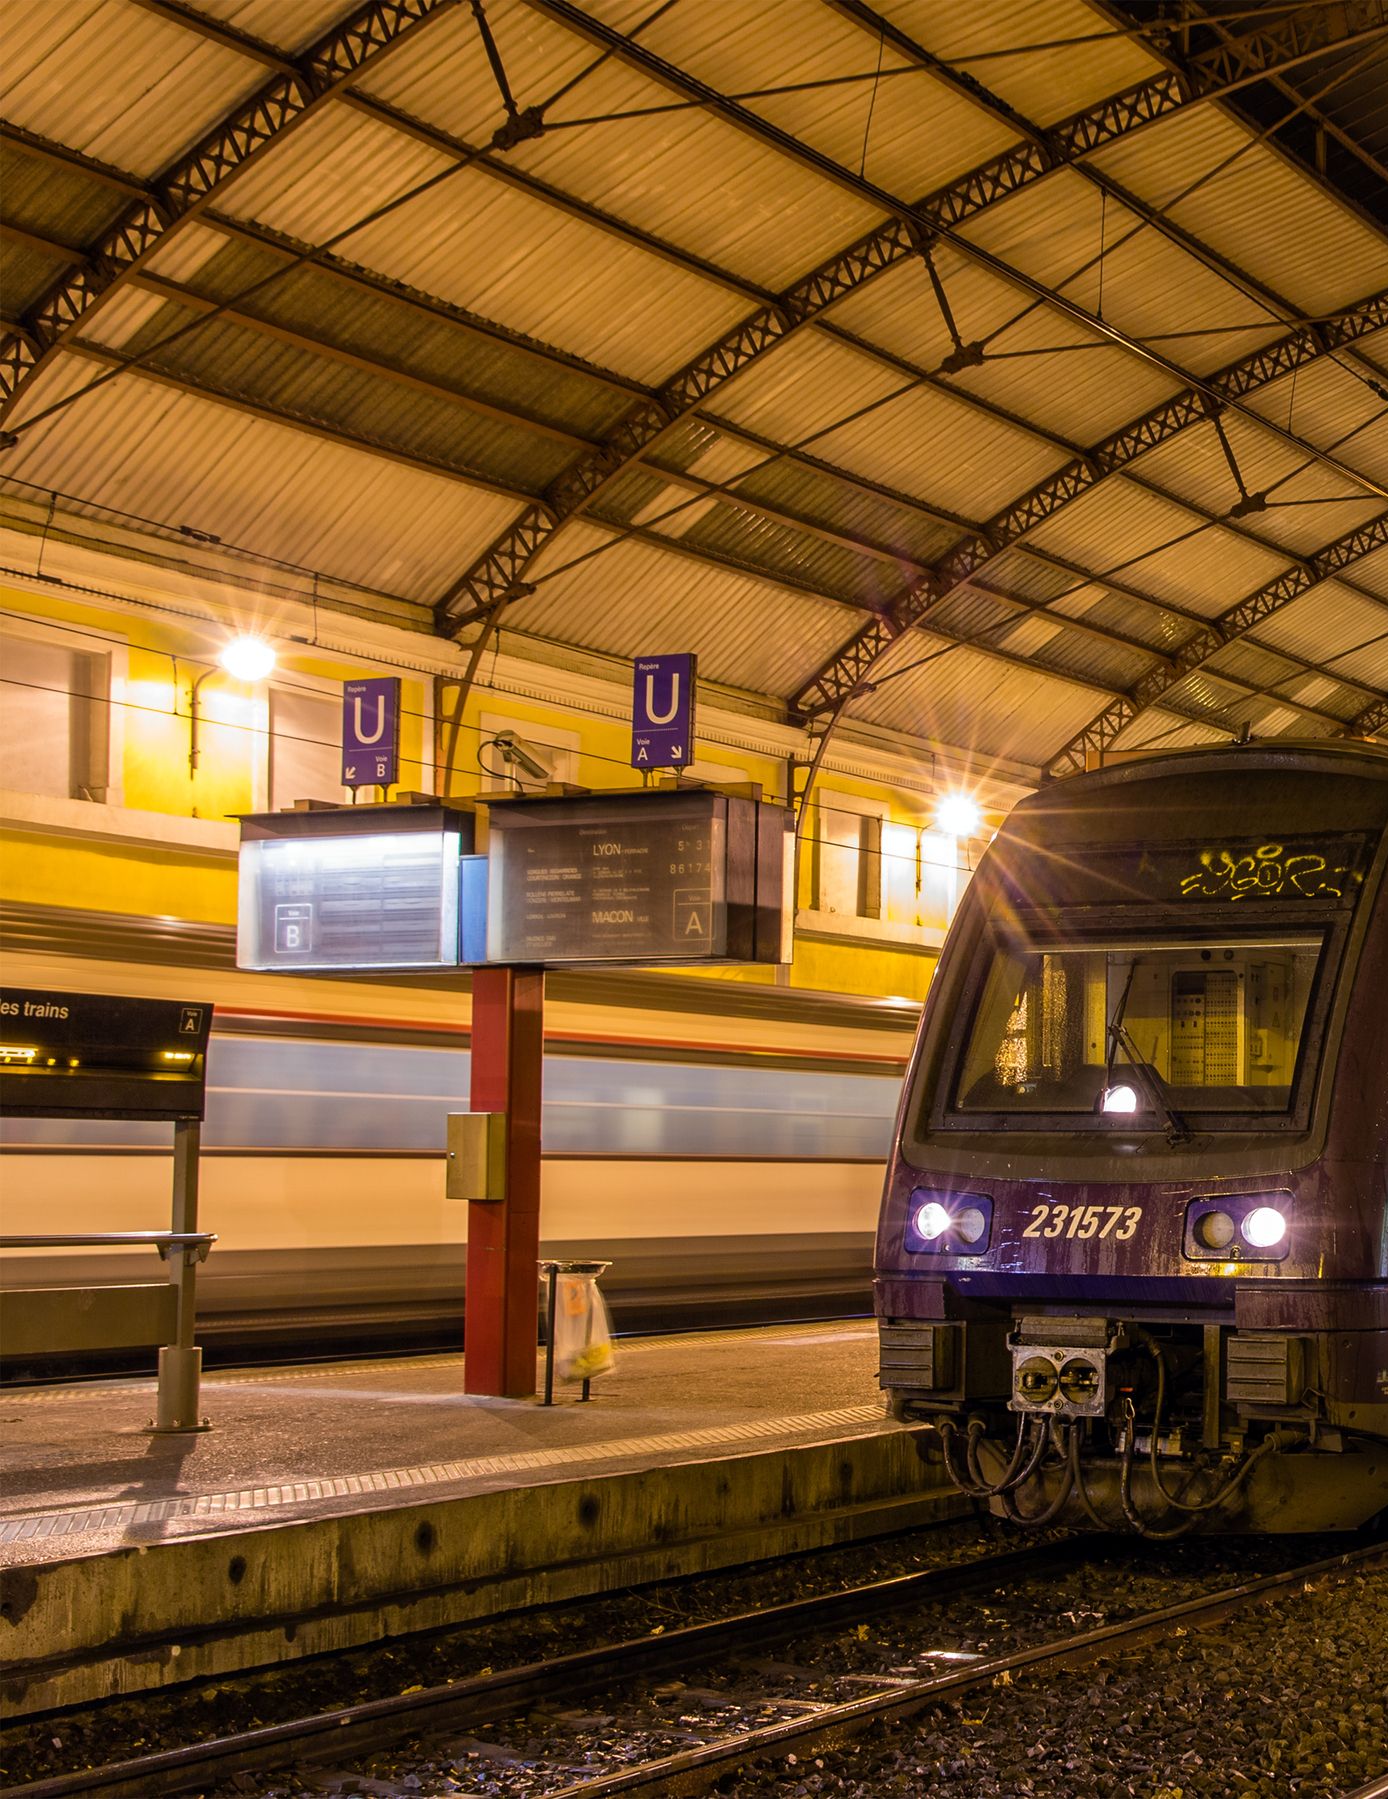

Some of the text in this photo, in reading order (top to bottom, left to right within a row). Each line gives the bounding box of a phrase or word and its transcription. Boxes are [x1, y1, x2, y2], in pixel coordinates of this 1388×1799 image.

[638, 663, 660, 671] Repère
[347, 686, 367, 694] Repère
[646, 672, 680, 725] U
[354, 694, 385, 745] U
[637, 738, 650, 746] Voie
[375, 755, 388, 763] Voie
[637, 746, 649, 761] A
[376, 763, 386, 778] B
[592, 910, 634, 924] MACON
[685, 911, 704, 935] A
[286, 925, 300, 948] B
[0, 998, 70, 1019] es trains
[185, 1018, 195, 1031] A
[1022, 1204, 1143, 1240] 231573
